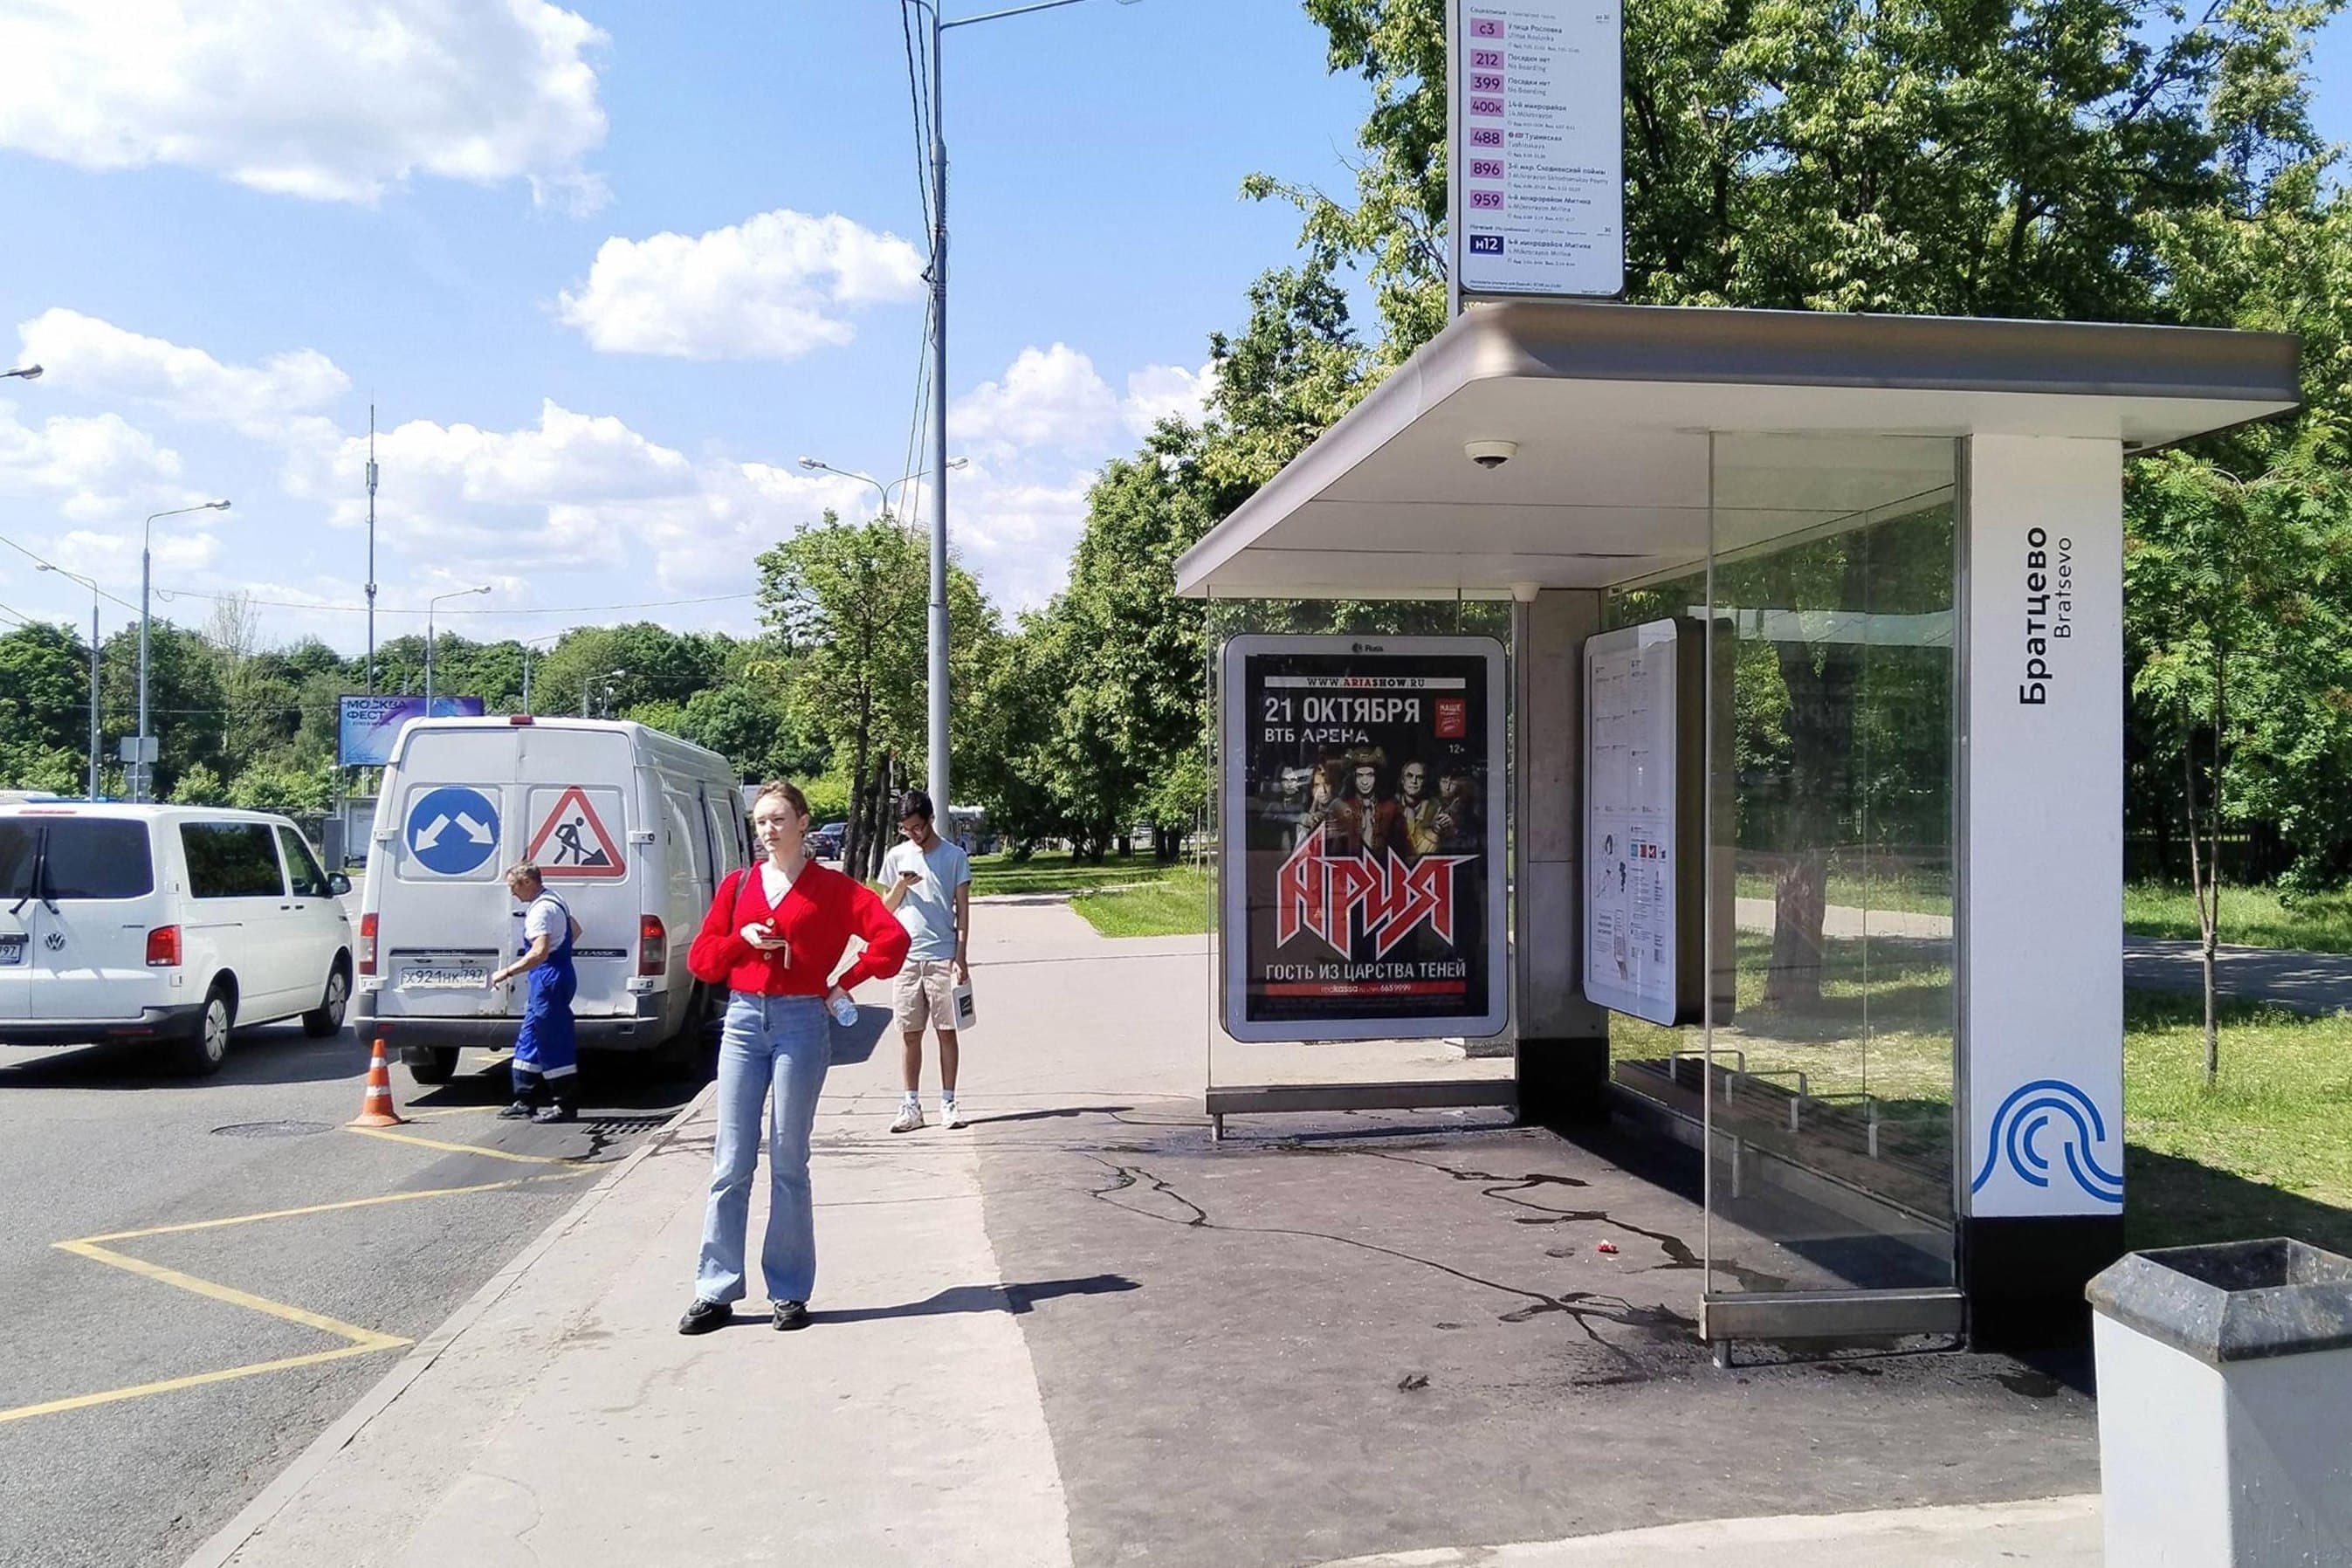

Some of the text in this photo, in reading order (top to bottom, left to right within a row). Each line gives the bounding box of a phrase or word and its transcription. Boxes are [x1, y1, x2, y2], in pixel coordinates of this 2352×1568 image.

[1476, 52, 1498, 66] 212
[1474, 77, 1500, 90] 399
[1472, 100, 1502, 113] 400к
[1474, 131, 1500, 145] 488
[1474, 162, 1500, 175] 896
[1474, 194, 1500, 207] 959
[1475, 237, 1498, 251] н12
[2054, 538, 2072, 638] Bratsevo
[2019, 527, 2053, 705] Братцево
[347, 700, 407, 710] МОСКВА
[1265, 698, 1291, 723] 21
[1303, 698, 1420, 723] ОКТЯБРЯ
[347, 711, 385, 720] ФЕСТ
[1265, 728, 1369, 743] ВТБ АРЕНА
[1277, 821, 1480, 960] АРИЯ
[1266, 959, 1466, 981] ГОСТЬ ИЗ ЦАРСТВА ТЕНЕЙ
